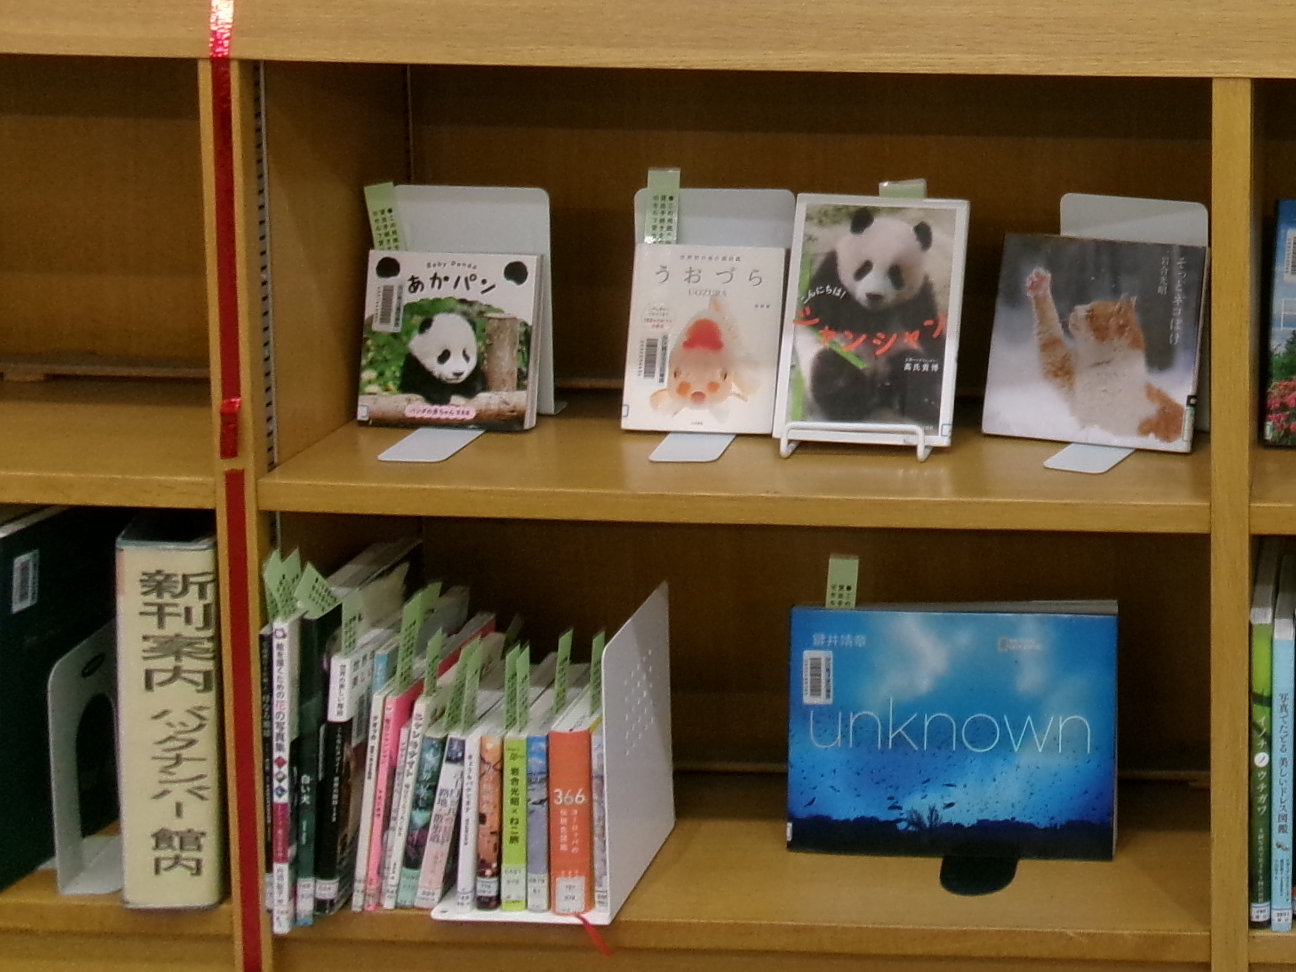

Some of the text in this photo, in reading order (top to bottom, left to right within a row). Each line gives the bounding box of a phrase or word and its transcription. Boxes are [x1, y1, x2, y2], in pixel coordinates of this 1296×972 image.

[406, 271, 498, 295] あかパン
[425, 260, 478, 271] Baby Panda
[654, 263, 767, 289] うおづら
[139, 569, 217, 695] 新刊案内
[809, 695, 1093, 755] unknown
[150, 704, 211, 820] バックナンバー
[1254, 715, 1270, 816] イノチノウチガワ
[1276, 692, 1290, 836] 写真でたどる 美しいドレス図鑑
[553, 788, 586, 805] 366
[150, 827, 209, 878] 館内
